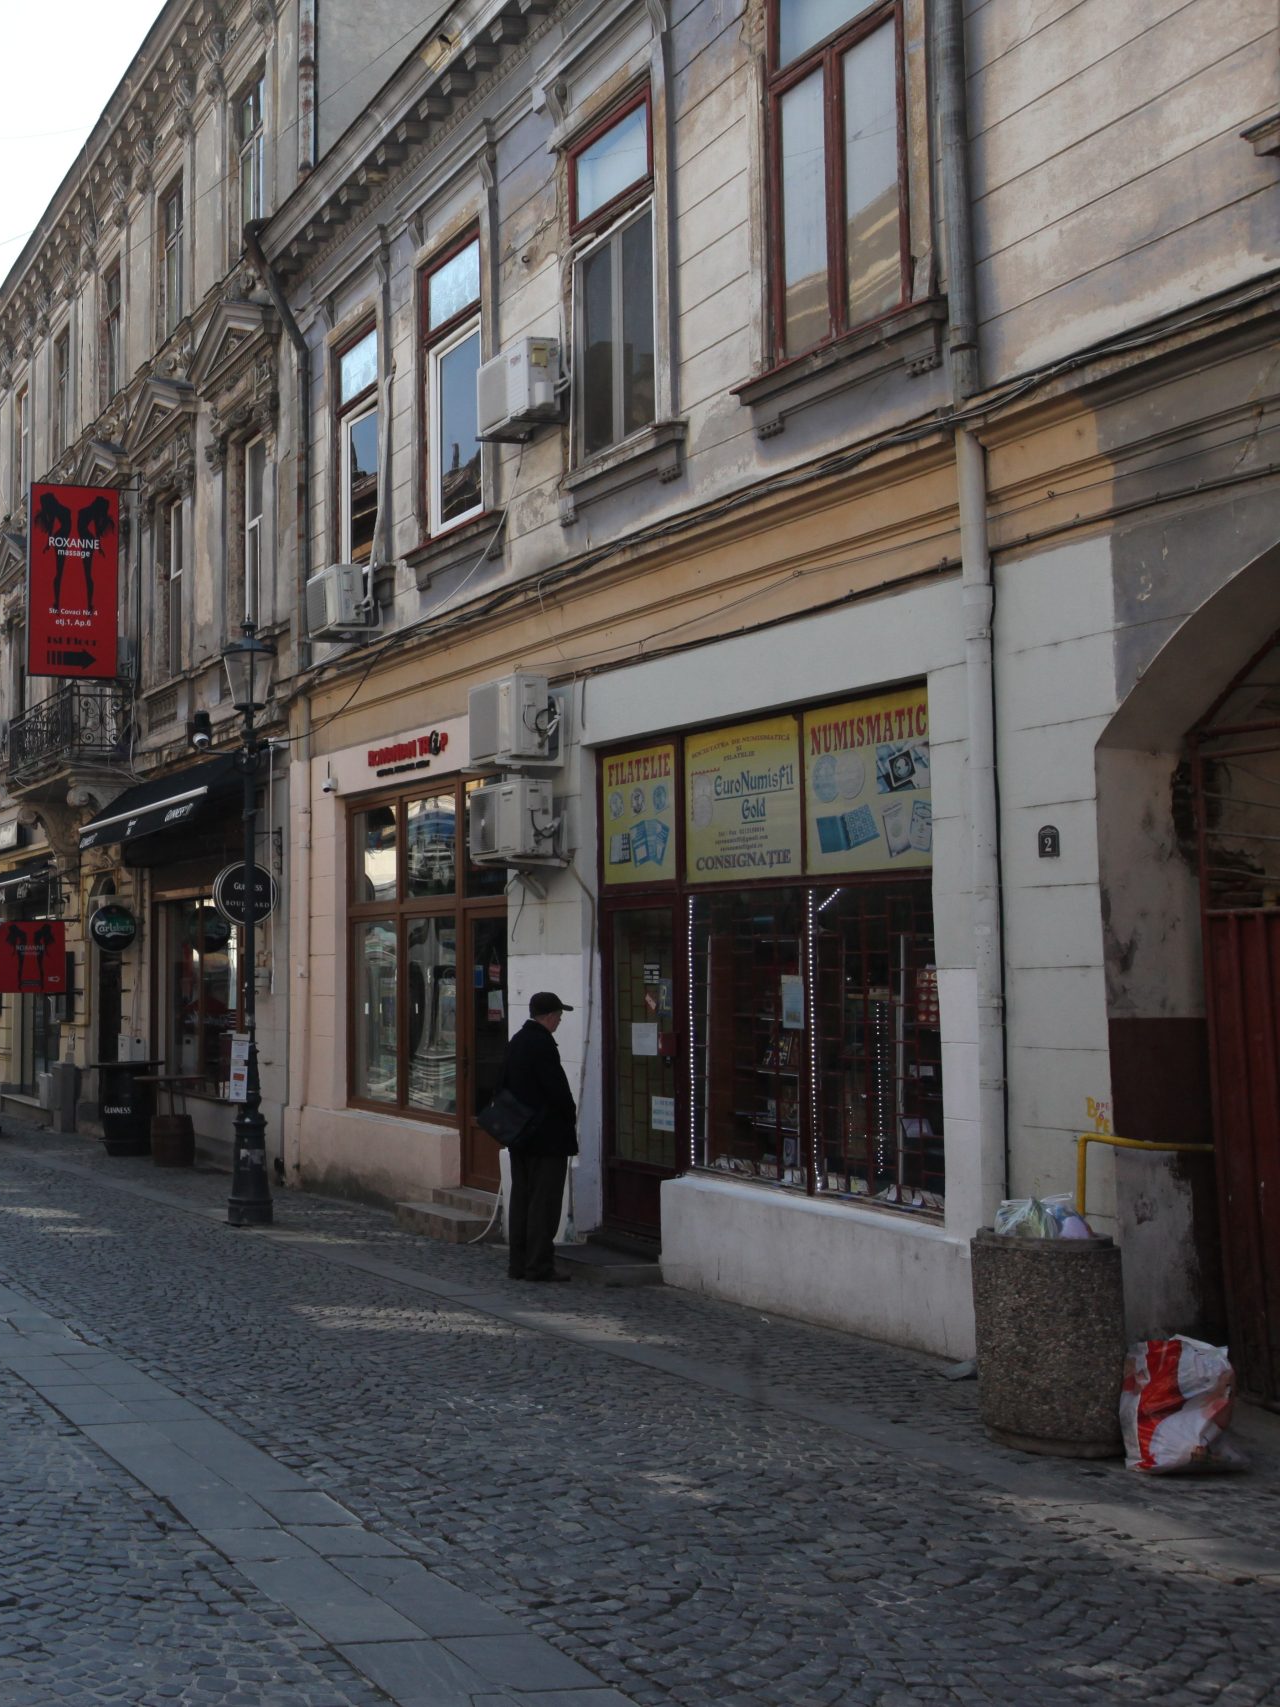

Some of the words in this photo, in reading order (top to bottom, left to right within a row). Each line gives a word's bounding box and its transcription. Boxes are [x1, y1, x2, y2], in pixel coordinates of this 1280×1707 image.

[49, 535, 100, 550] ROXANNE
[57, 548, 90, 559] massage
[608, 752, 671, 787] FILATELIE
[741, 797, 766, 820] Gold
[1044, 837, 1052, 852] 2
[225, 900, 271, 909] BOULARD
